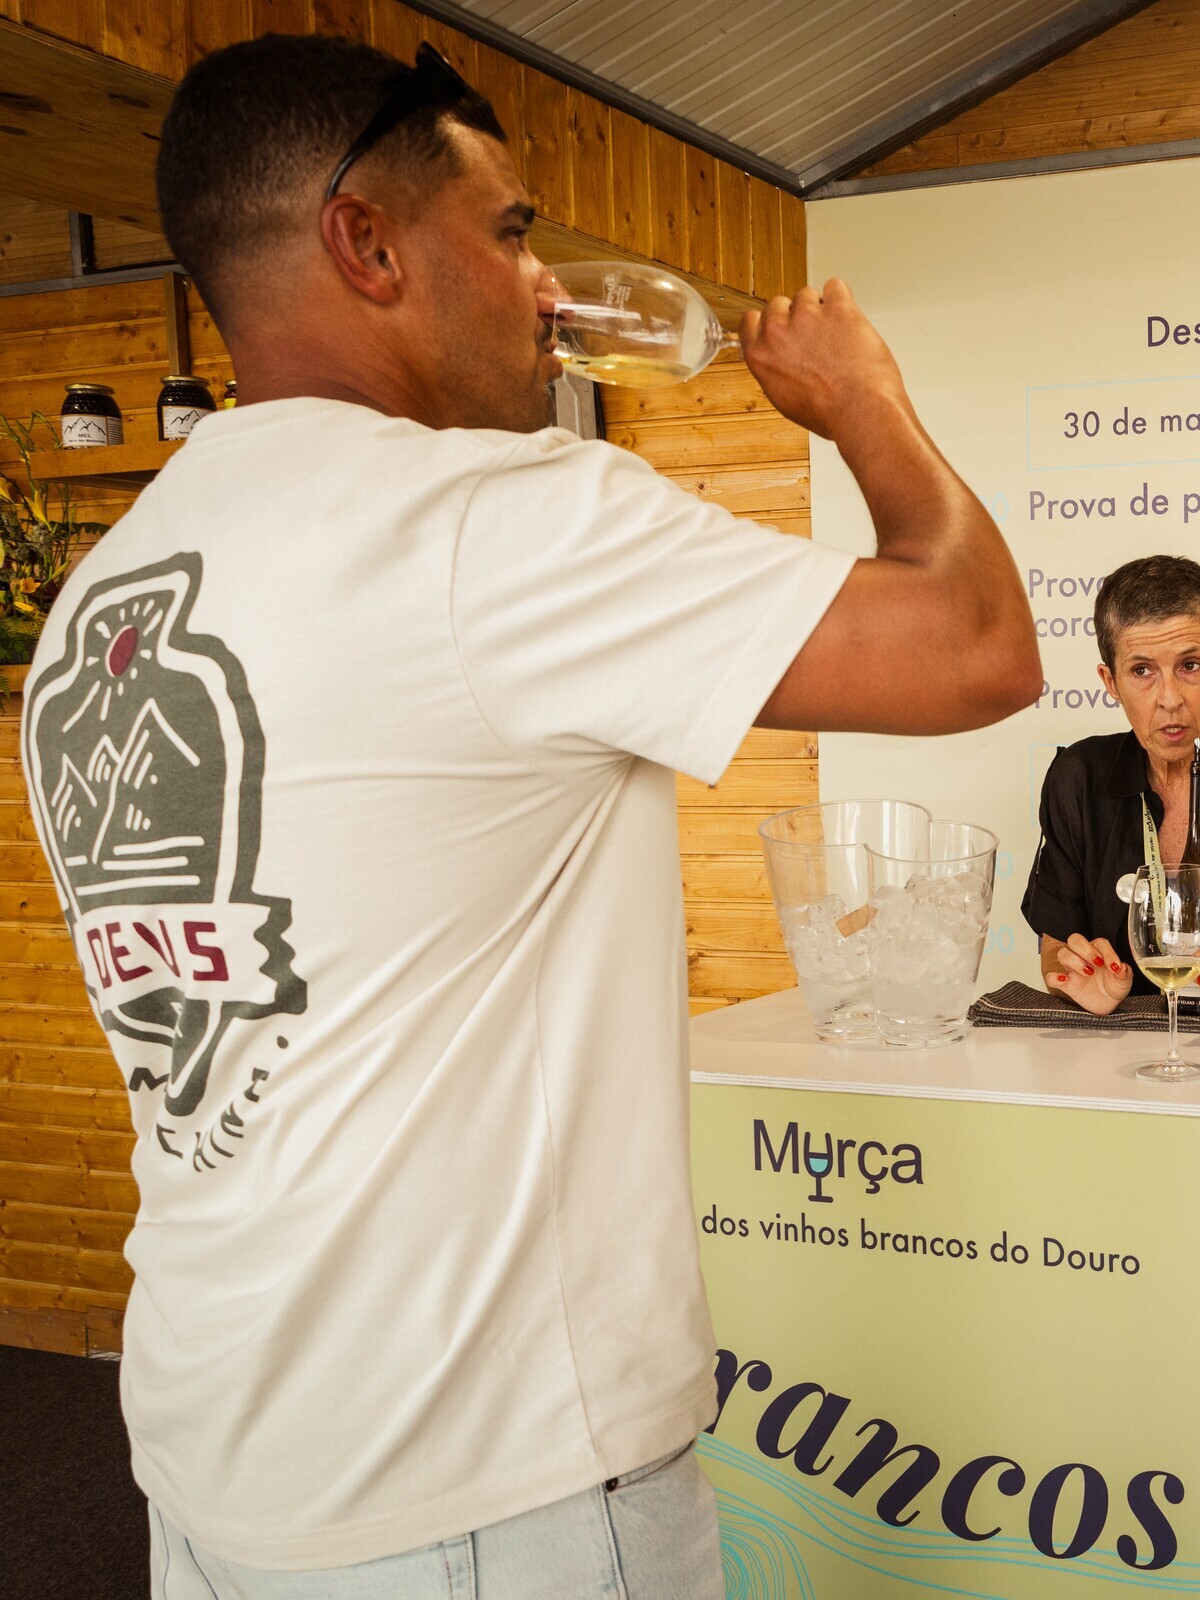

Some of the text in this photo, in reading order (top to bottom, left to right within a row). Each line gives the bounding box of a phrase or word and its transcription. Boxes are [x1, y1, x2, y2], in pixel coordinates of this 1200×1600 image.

[1063, 410, 1100, 439] 30
[1112, 406, 1147, 436] de
[1029, 490, 1116, 521] Prova
[1129, 482, 1169, 516] de
[753, 1118, 925, 1204] Murça
[701, 1204, 1141, 1275] dos vinhos brancos do Douro
